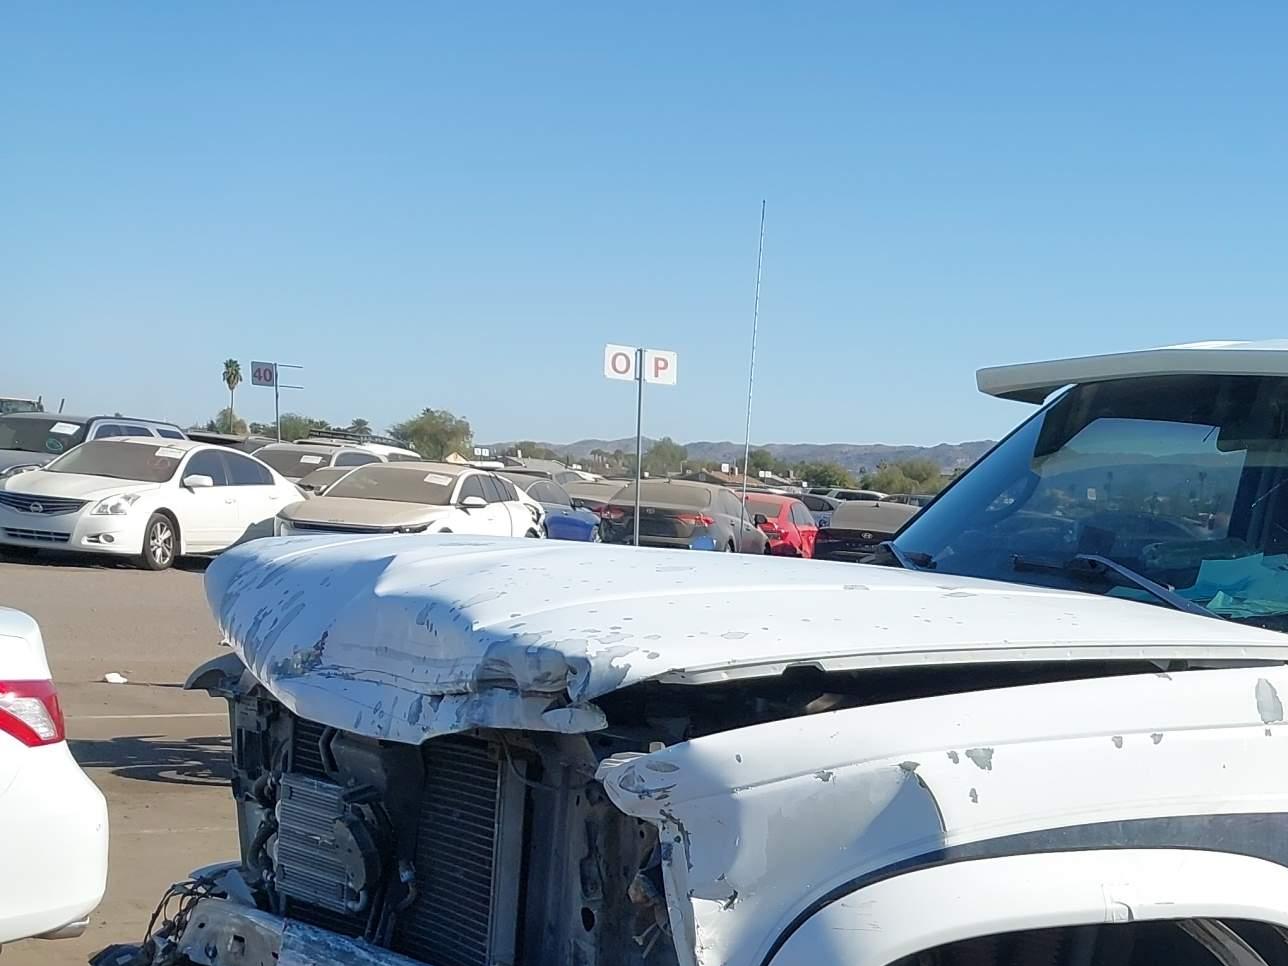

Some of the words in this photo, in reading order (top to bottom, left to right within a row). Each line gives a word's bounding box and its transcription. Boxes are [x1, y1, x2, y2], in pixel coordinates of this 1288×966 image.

[611, 352, 631, 374] O
[654, 356, 669, 378] P
[253, 367, 273, 382] 40
